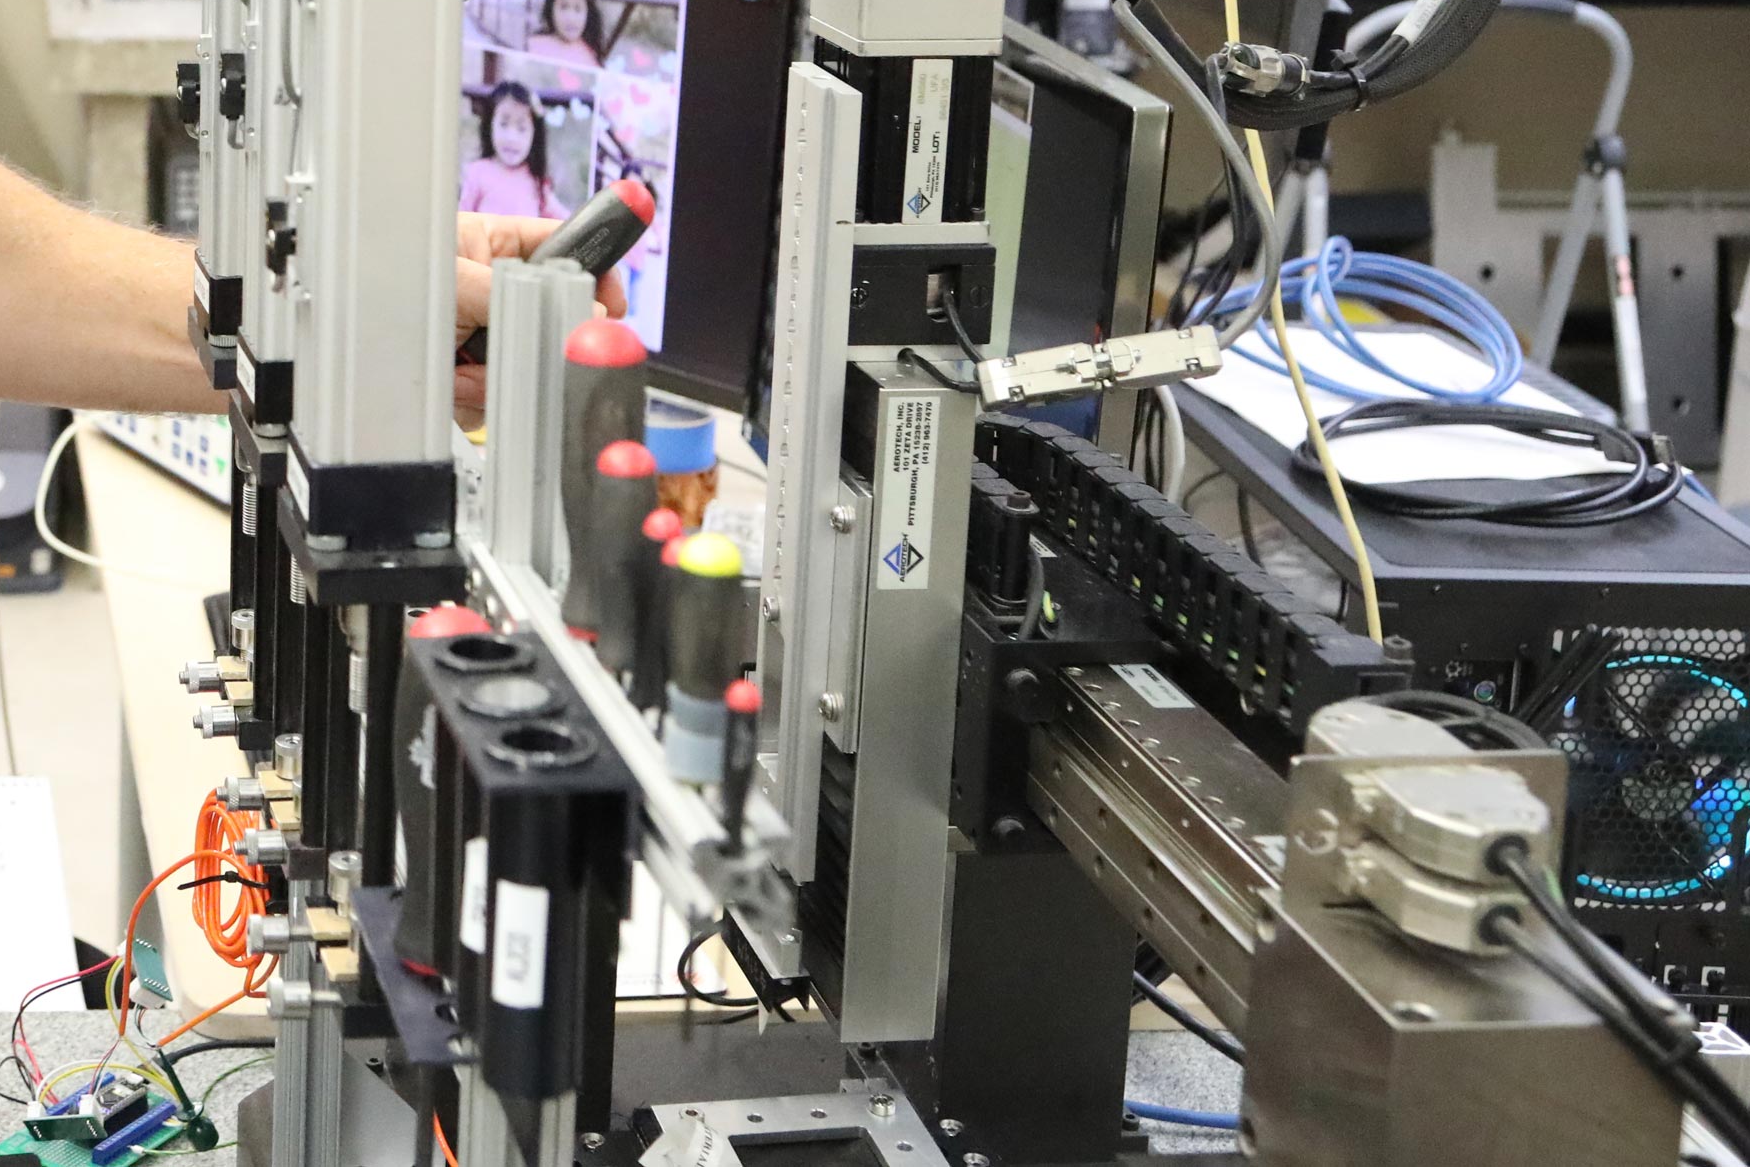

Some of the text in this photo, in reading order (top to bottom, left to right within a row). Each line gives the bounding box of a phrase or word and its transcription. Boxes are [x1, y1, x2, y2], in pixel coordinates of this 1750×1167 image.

[912, 115, 922, 154] MODEL:
[932, 131, 941, 154] LOT:
[893, 401, 905, 472] AEROTECH, INC.
[902, 401, 914, 471] 101 ZETA DRIVE
[912, 453, 920, 465] PA
[921, 401, 933, 465] (412) 963-7470
[907, 466, 920, 526] PITTSBURGH,
[899, 532, 909, 583] AEROTECH
